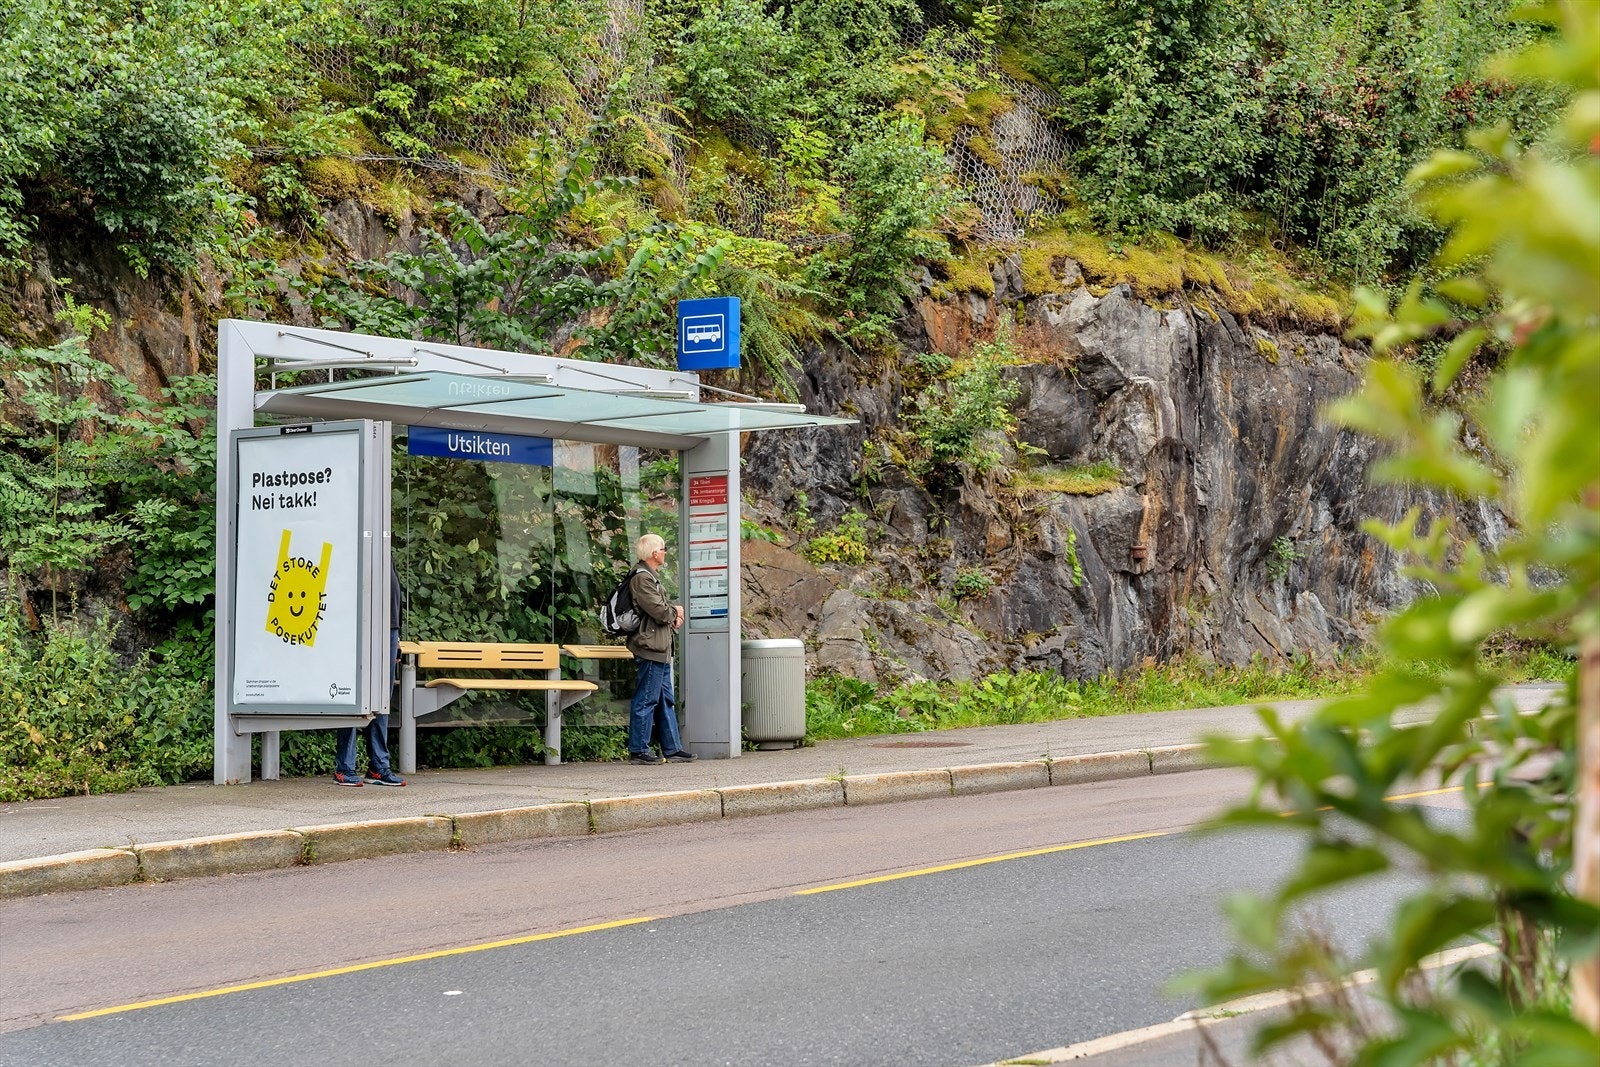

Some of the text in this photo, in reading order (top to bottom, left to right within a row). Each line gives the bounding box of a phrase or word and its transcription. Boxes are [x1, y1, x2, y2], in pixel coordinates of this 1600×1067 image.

[448, 433, 510, 456] Utsikten
[252, 467, 332, 488] Plastpose?
[252, 491, 317, 510] Nei takk!
[267, 557, 320, 602] DET STORE
[270, 591, 327, 646] POSEKUTTET
